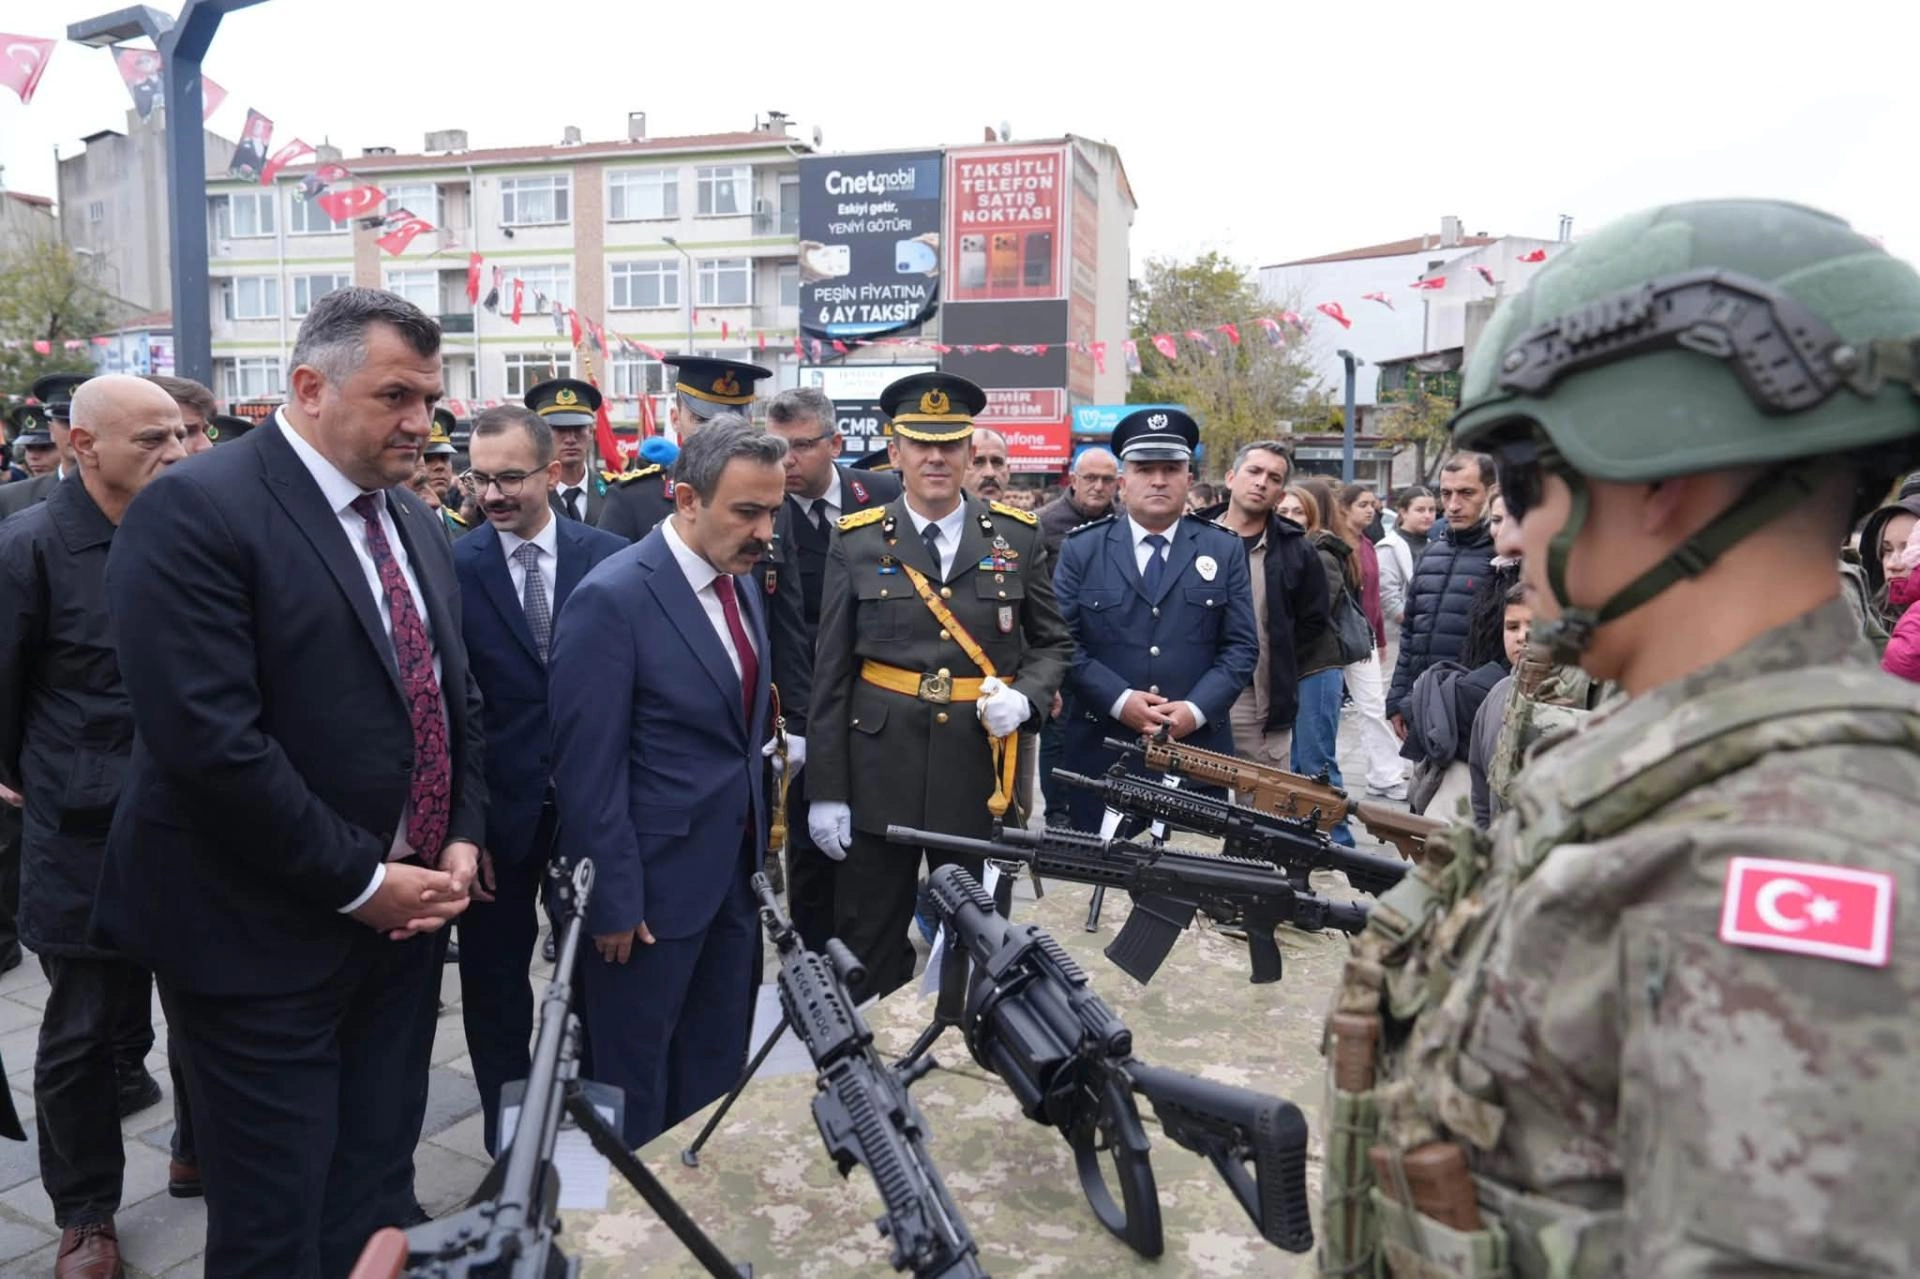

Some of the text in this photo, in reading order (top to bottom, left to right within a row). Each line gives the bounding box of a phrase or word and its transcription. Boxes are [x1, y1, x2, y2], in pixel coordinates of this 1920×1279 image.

[960, 157, 1055, 178] TAKSİTLİ
[961, 175, 1053, 193] TELEFON
[837, 200, 898, 216] Eskiyi getir,
[978, 191, 1036, 208] SATIŞ
[962, 206, 1051, 223] NOKTASI
[828, 219, 864, 235] YENİYİ
[814, 283, 926, 304] PEŞİN FİYATINA
[819, 300, 920, 323] 6 AY TAKSİT
[985, 391, 1032, 404] EMİR
[981, 404, 1042, 416] ETİŞİM
[837, 417, 880, 436] CMR
[1005, 431, 1046, 446] afone
